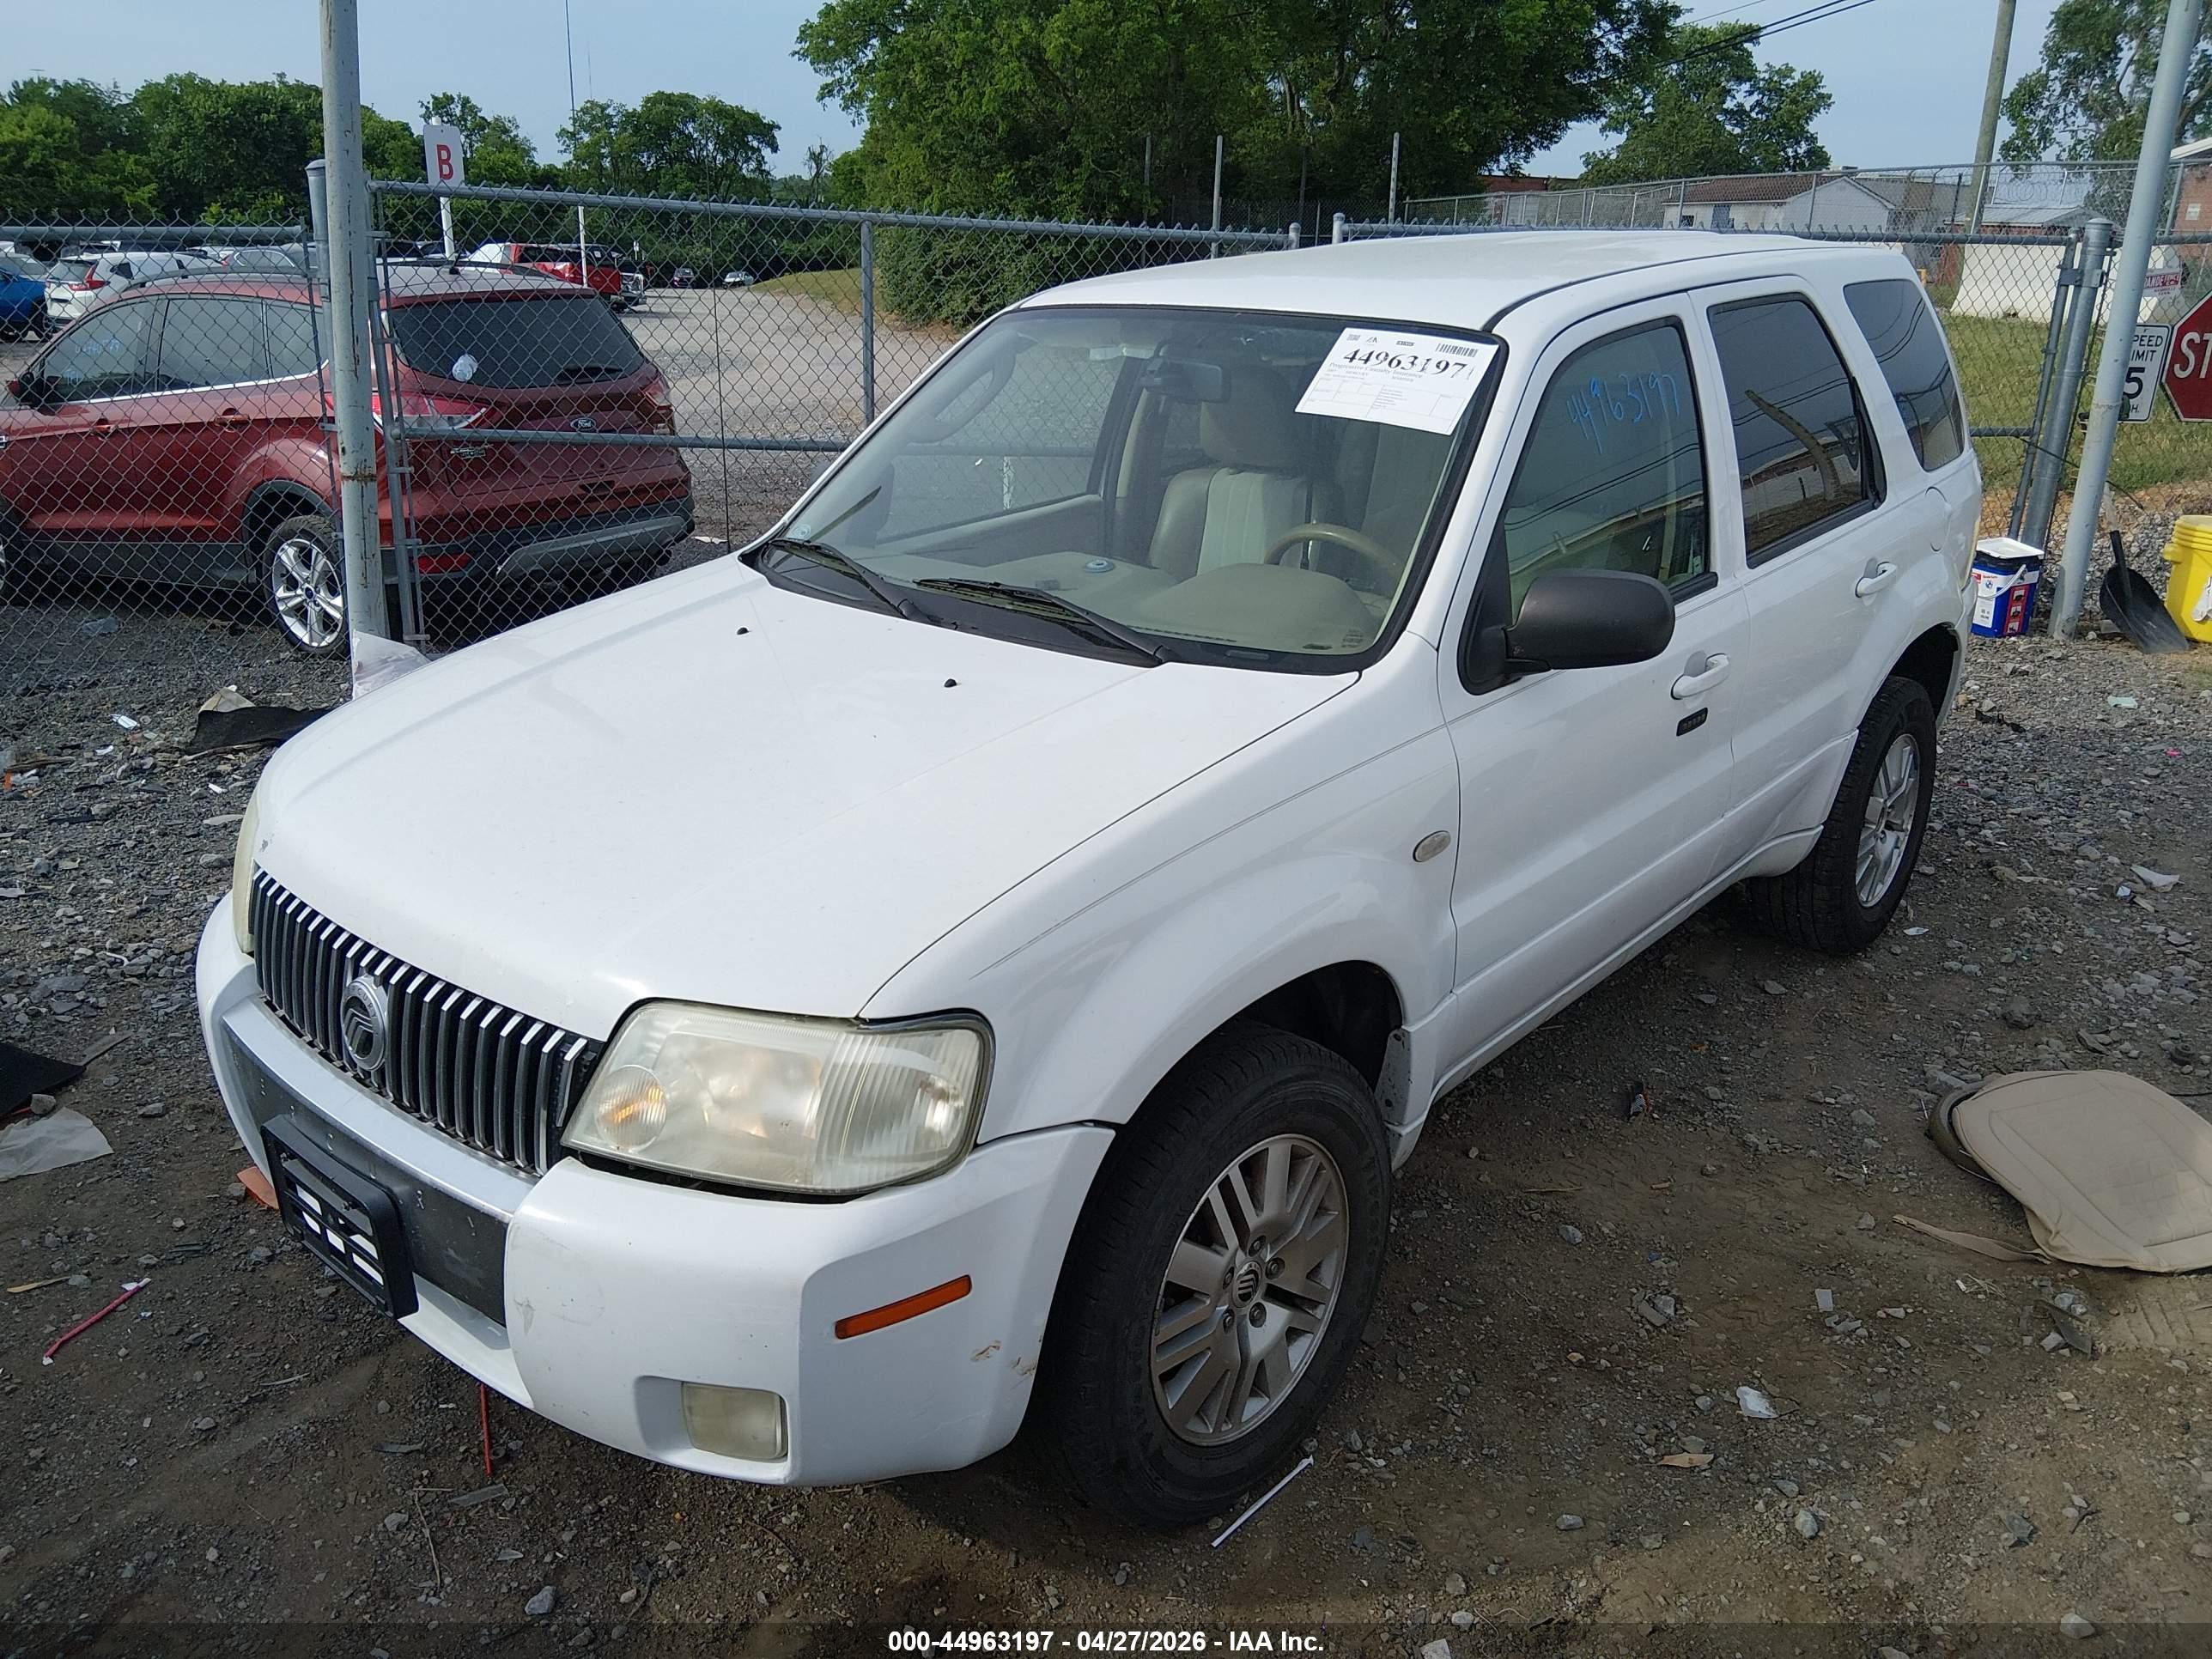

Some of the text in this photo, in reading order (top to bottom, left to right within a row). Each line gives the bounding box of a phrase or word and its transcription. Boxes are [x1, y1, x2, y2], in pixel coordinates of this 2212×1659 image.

[436, 143, 454, 180] B
[2130, 349, 2157, 362] IMIT
[2133, 335, 2163, 347] PEED
[2173, 331, 2212, 379] ST
[1343, 348, 1468, 379] 44963197
[1566, 371, 1680, 455] 44963197
